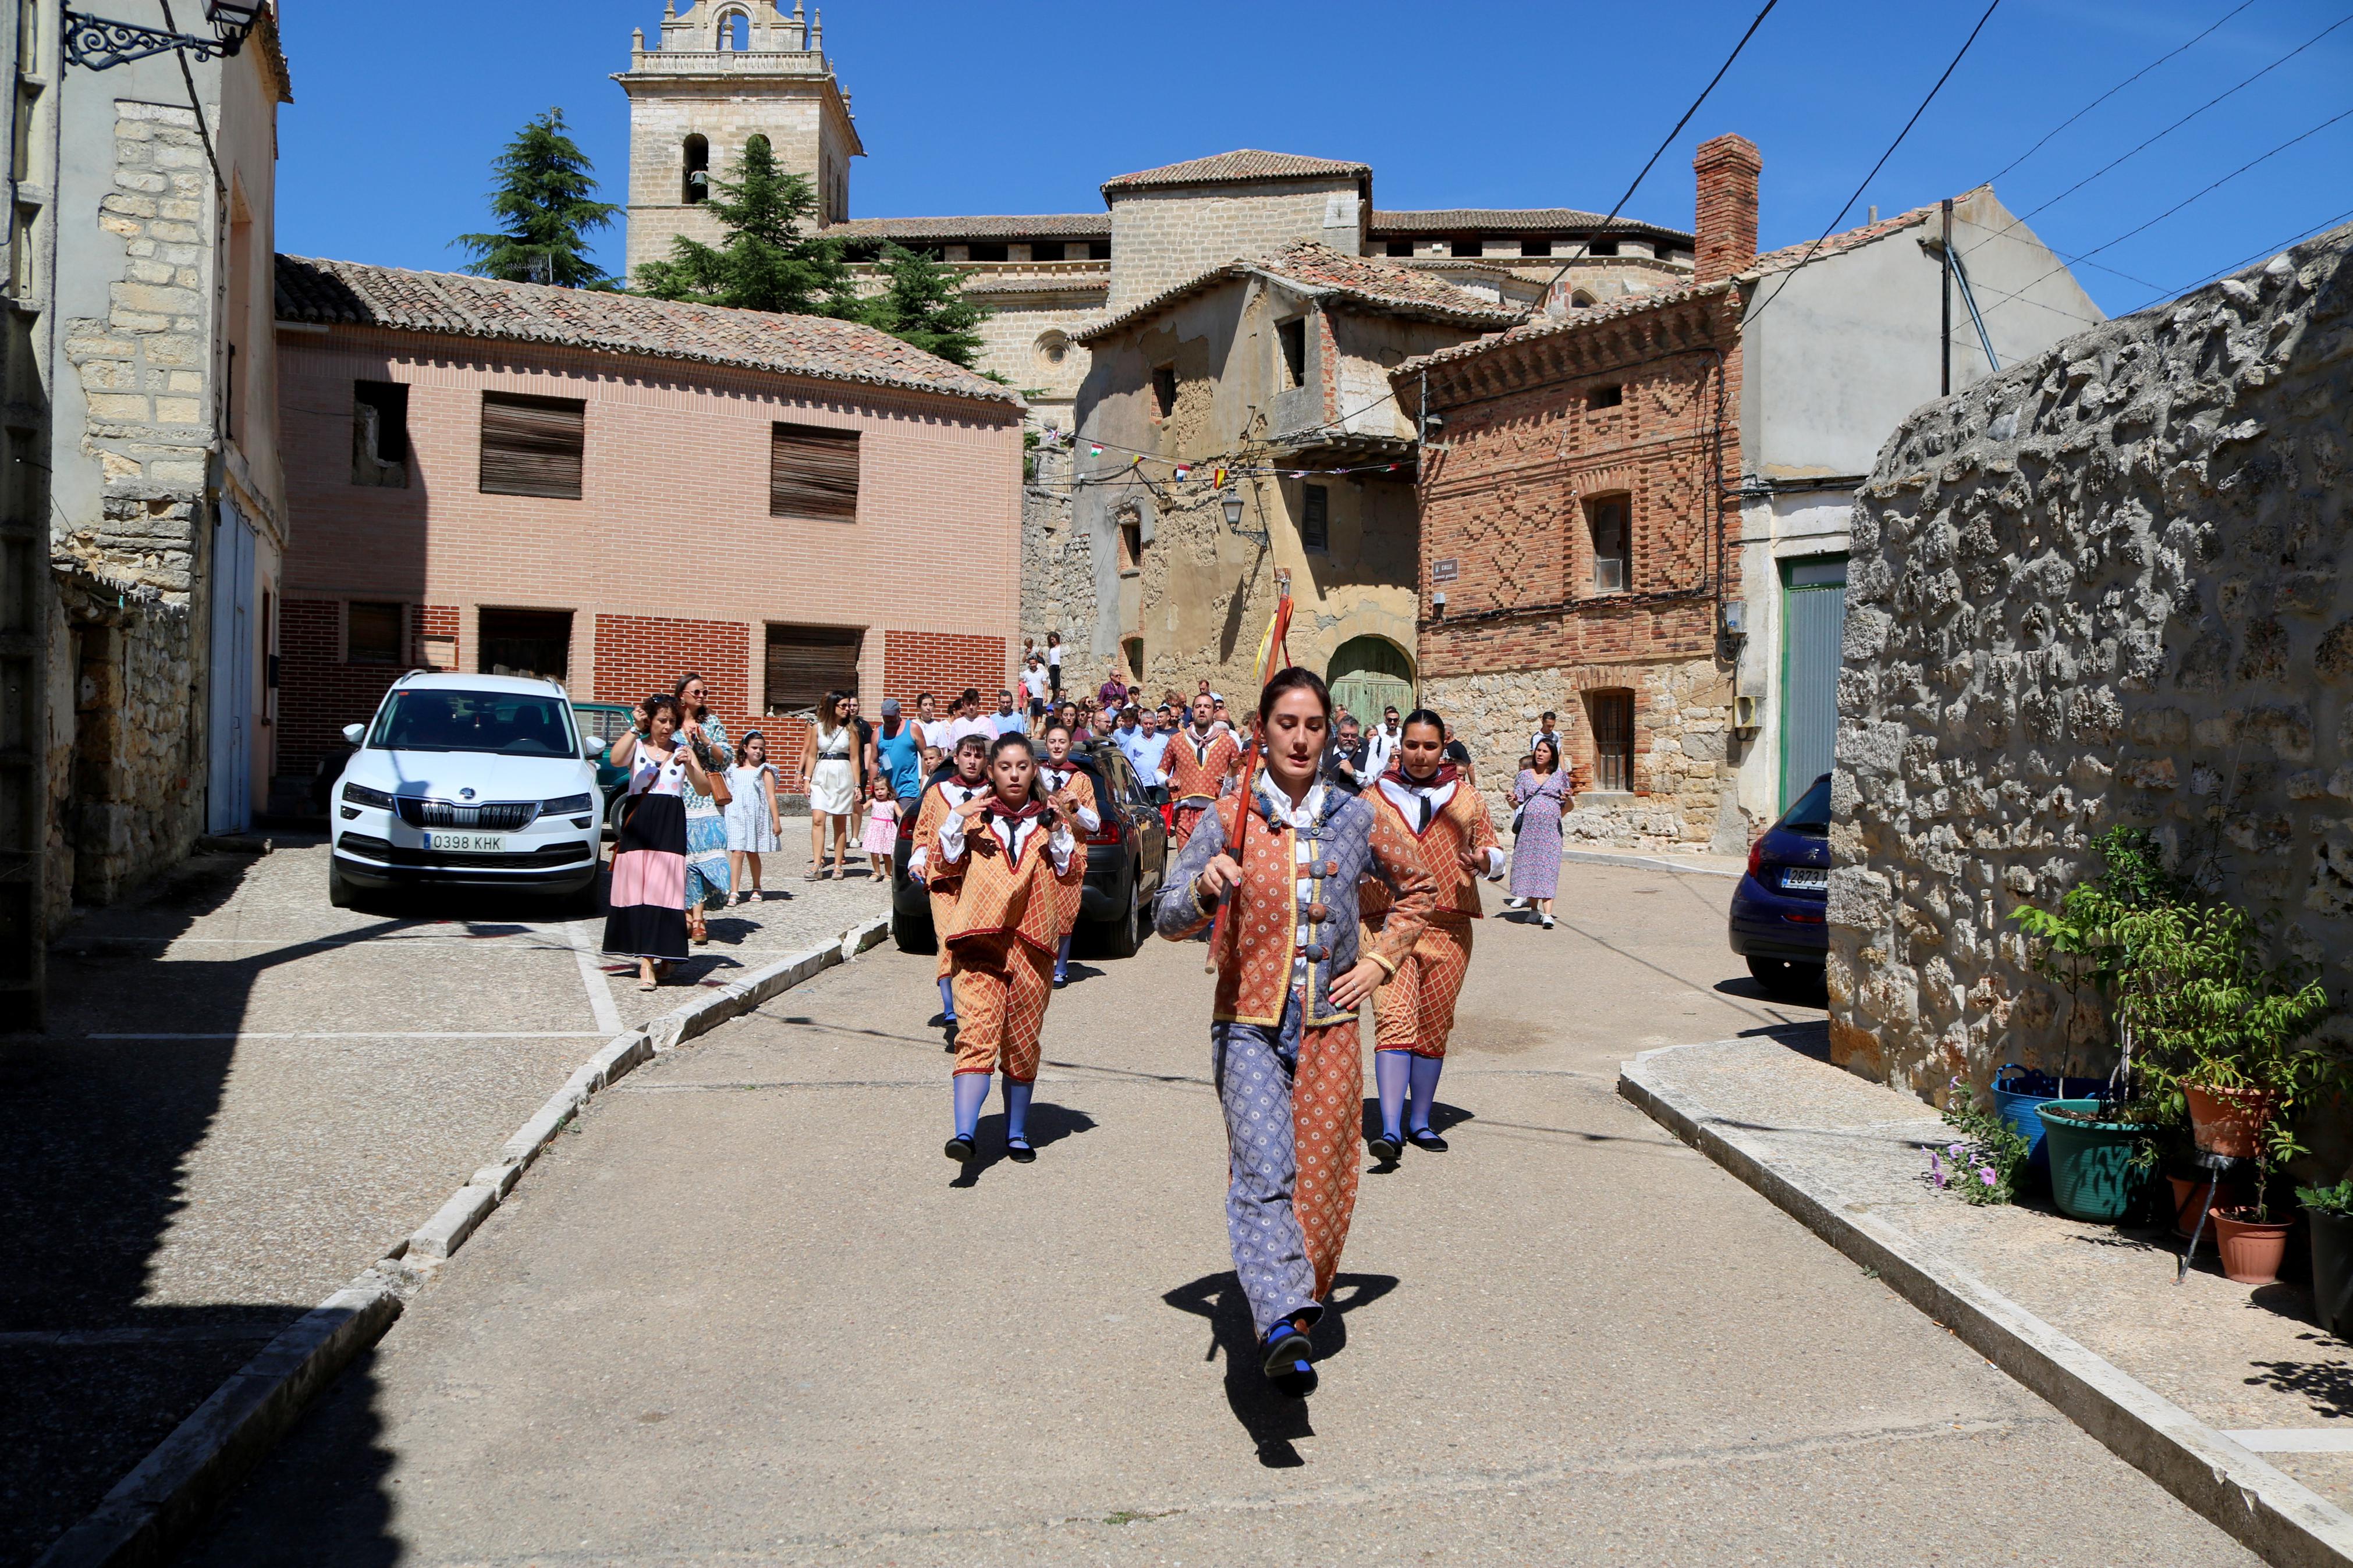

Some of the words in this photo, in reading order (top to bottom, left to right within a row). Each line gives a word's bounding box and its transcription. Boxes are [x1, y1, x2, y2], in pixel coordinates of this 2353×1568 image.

[434, 835, 469, 849] 0398
[475, 837, 501, 849] KHK
[1790, 870, 1819, 884] 2873
